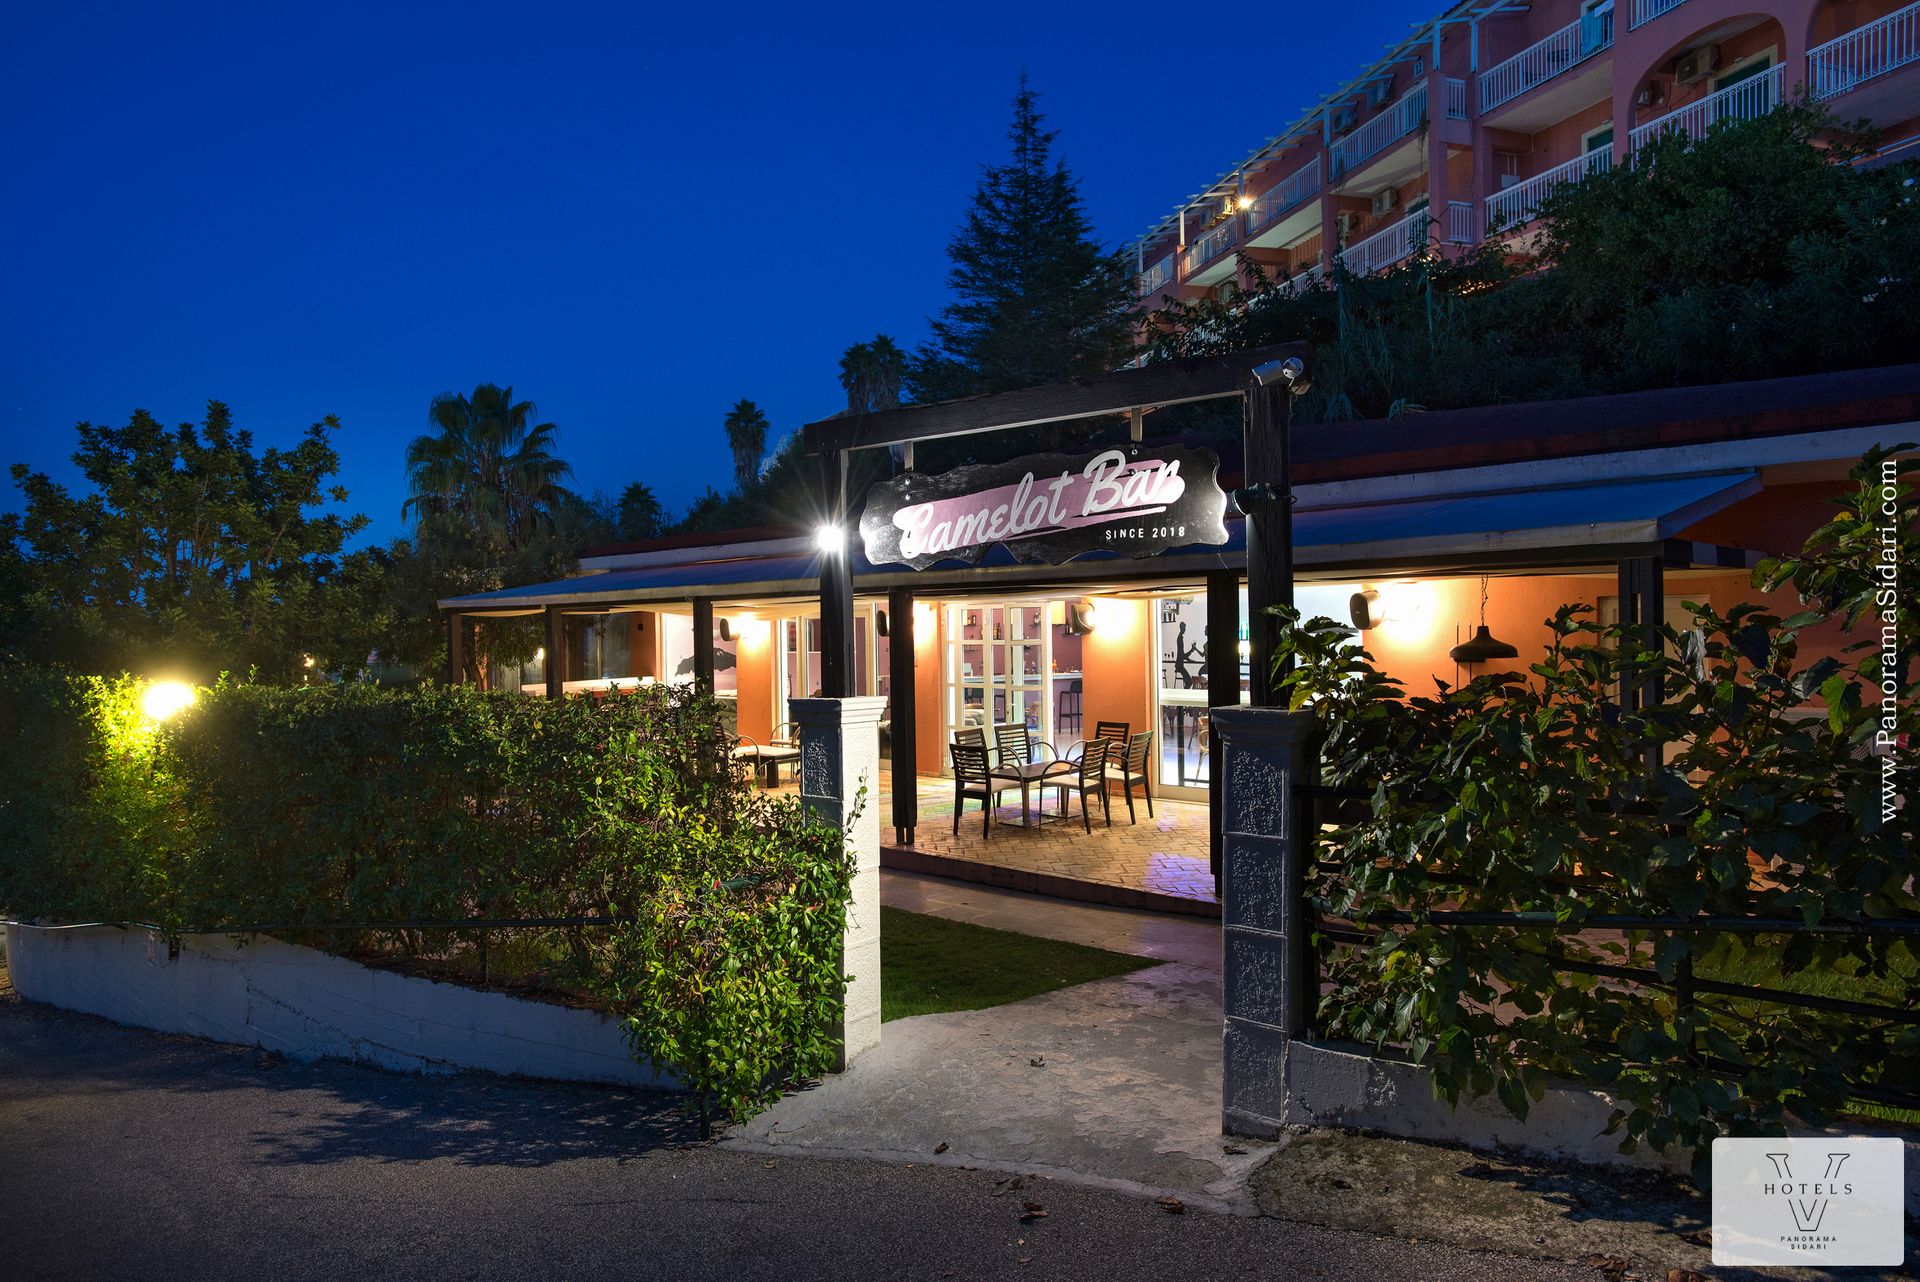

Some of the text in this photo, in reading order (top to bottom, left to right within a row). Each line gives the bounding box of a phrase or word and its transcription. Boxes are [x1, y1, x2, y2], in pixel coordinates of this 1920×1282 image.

[900, 450, 1183, 559] Camelot Bar
[1105, 526, 1187, 541] SINCE 2018
